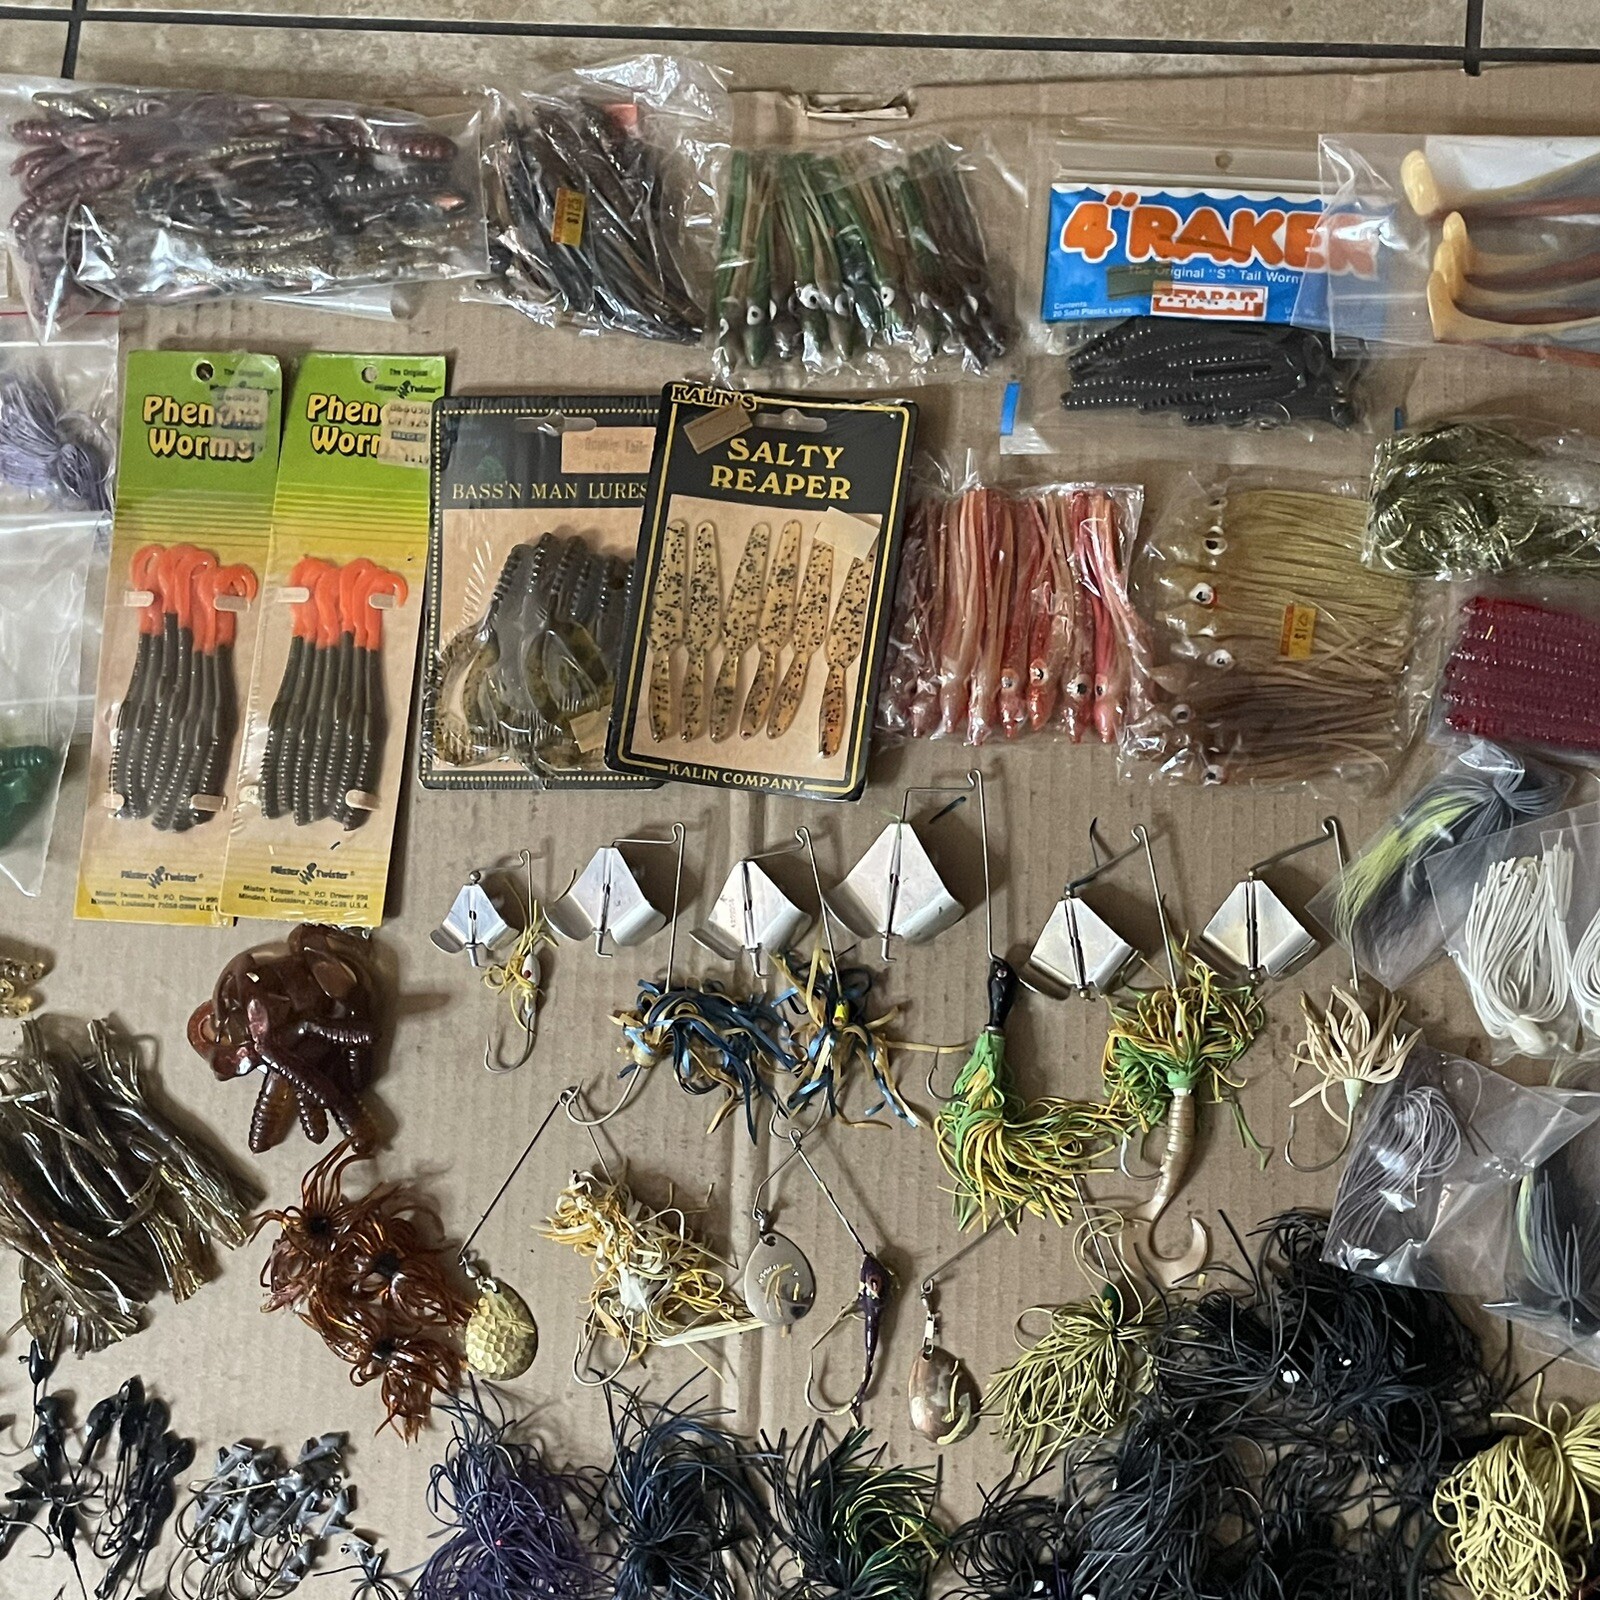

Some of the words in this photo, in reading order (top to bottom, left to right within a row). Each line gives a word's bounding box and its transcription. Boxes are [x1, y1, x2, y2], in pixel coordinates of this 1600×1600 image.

[1126, 204, 1378, 281] RAKER
[1154, 265, 1205, 279] Original
[1239, 270, 1262, 283] Tail
[1053, 301, 1088, 310] Contents
[1064, 309, 1080, 317] Soft
[1081, 307, 1107, 316] Plastic
[403, 368, 428, 377] Original
[142, 394, 250, 428] Phen
[307, 393, 381, 425] Phen
[671, 384, 757, 412] KALIN'S
[148, 427, 254, 462] Worms
[311, 425, 380, 457] Wor
[727, 437, 845, 469] SALTY
[452, 480, 522, 500] BASS'N
[531, 483, 578, 500] MAN
[588, 483, 648, 500] LURES
[709, 464, 852, 500] REAPER
[669, 763, 719, 783] KALIN
[722, 771, 804, 792] COMPANY
[316, 869, 349, 880] Twister
